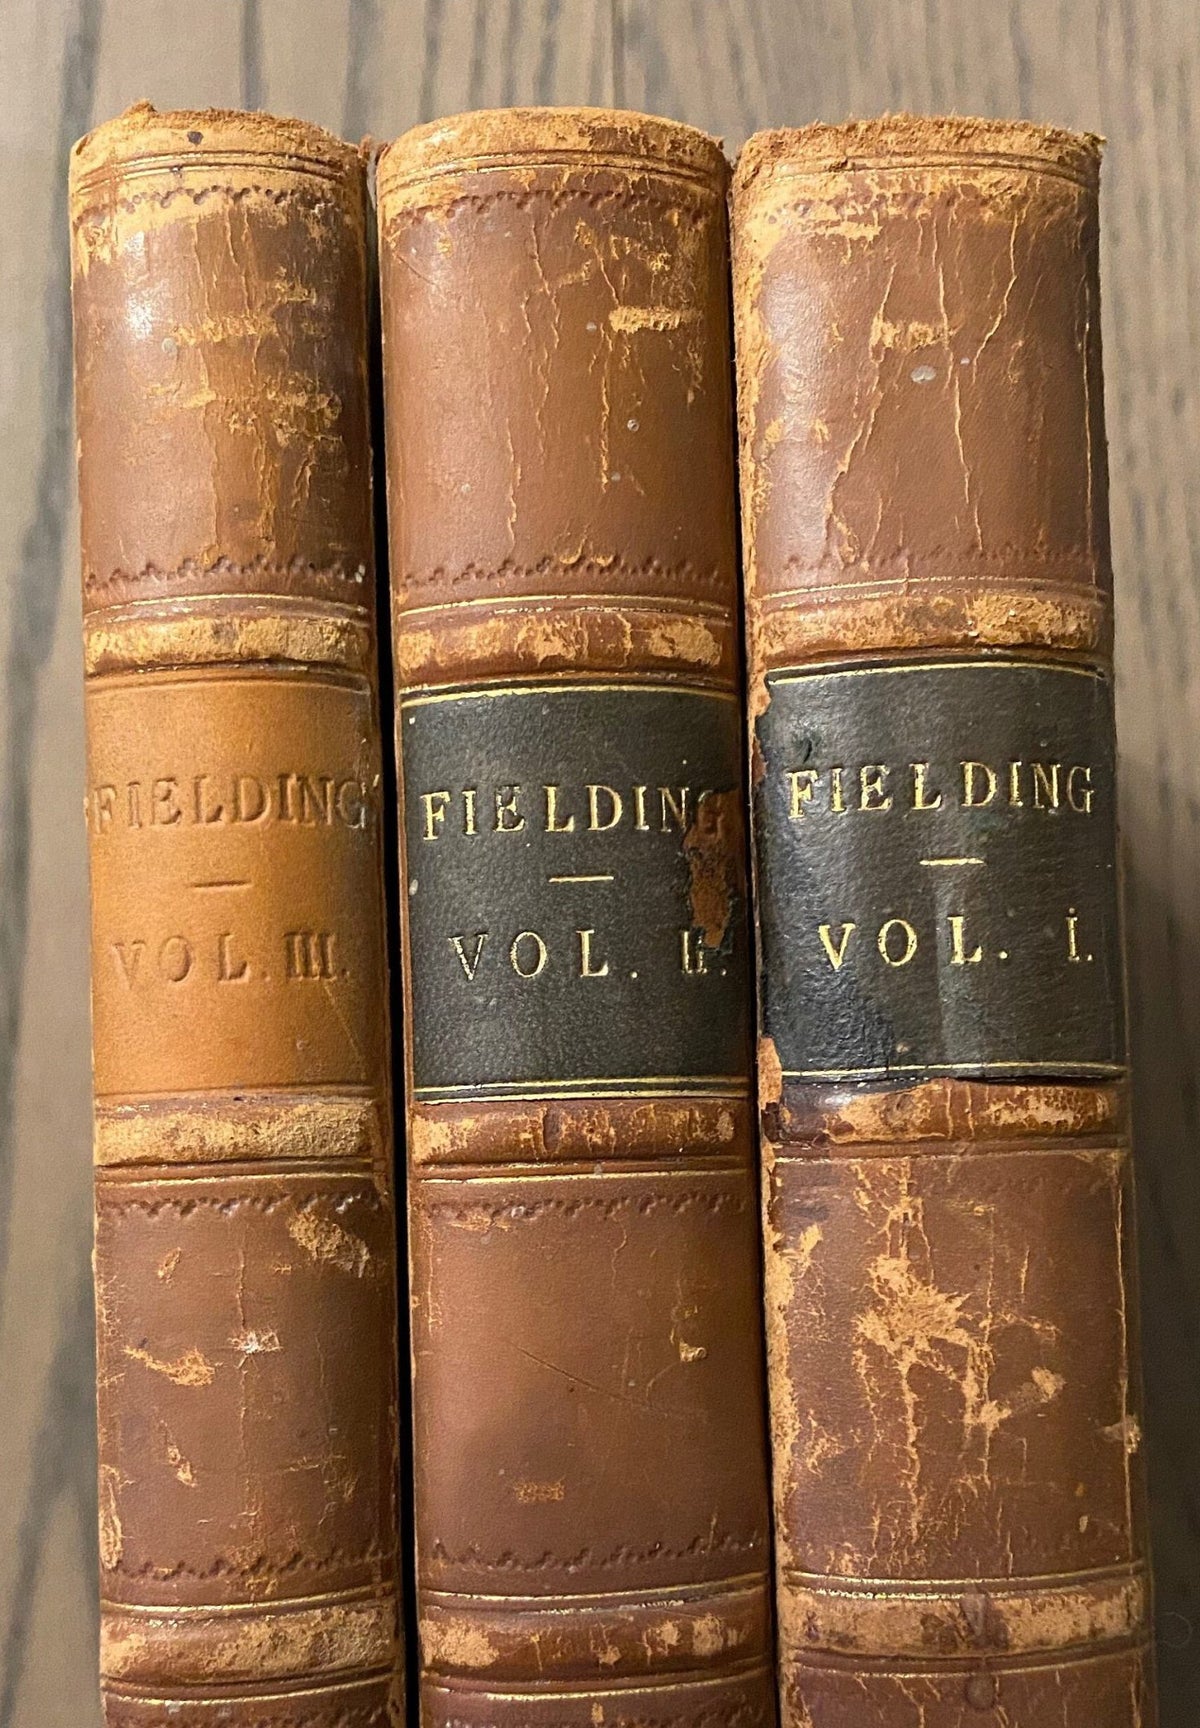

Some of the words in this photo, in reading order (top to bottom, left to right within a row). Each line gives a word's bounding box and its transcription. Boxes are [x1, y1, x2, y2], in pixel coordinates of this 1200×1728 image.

[91, 772, 367, 834] FIELDING
[785, 761, 1095, 819] FIELDING
[110, 932, 272, 990] VOL.
[449, 929, 638, 981] VOL.
[818, 915, 1008, 970] VOL.
